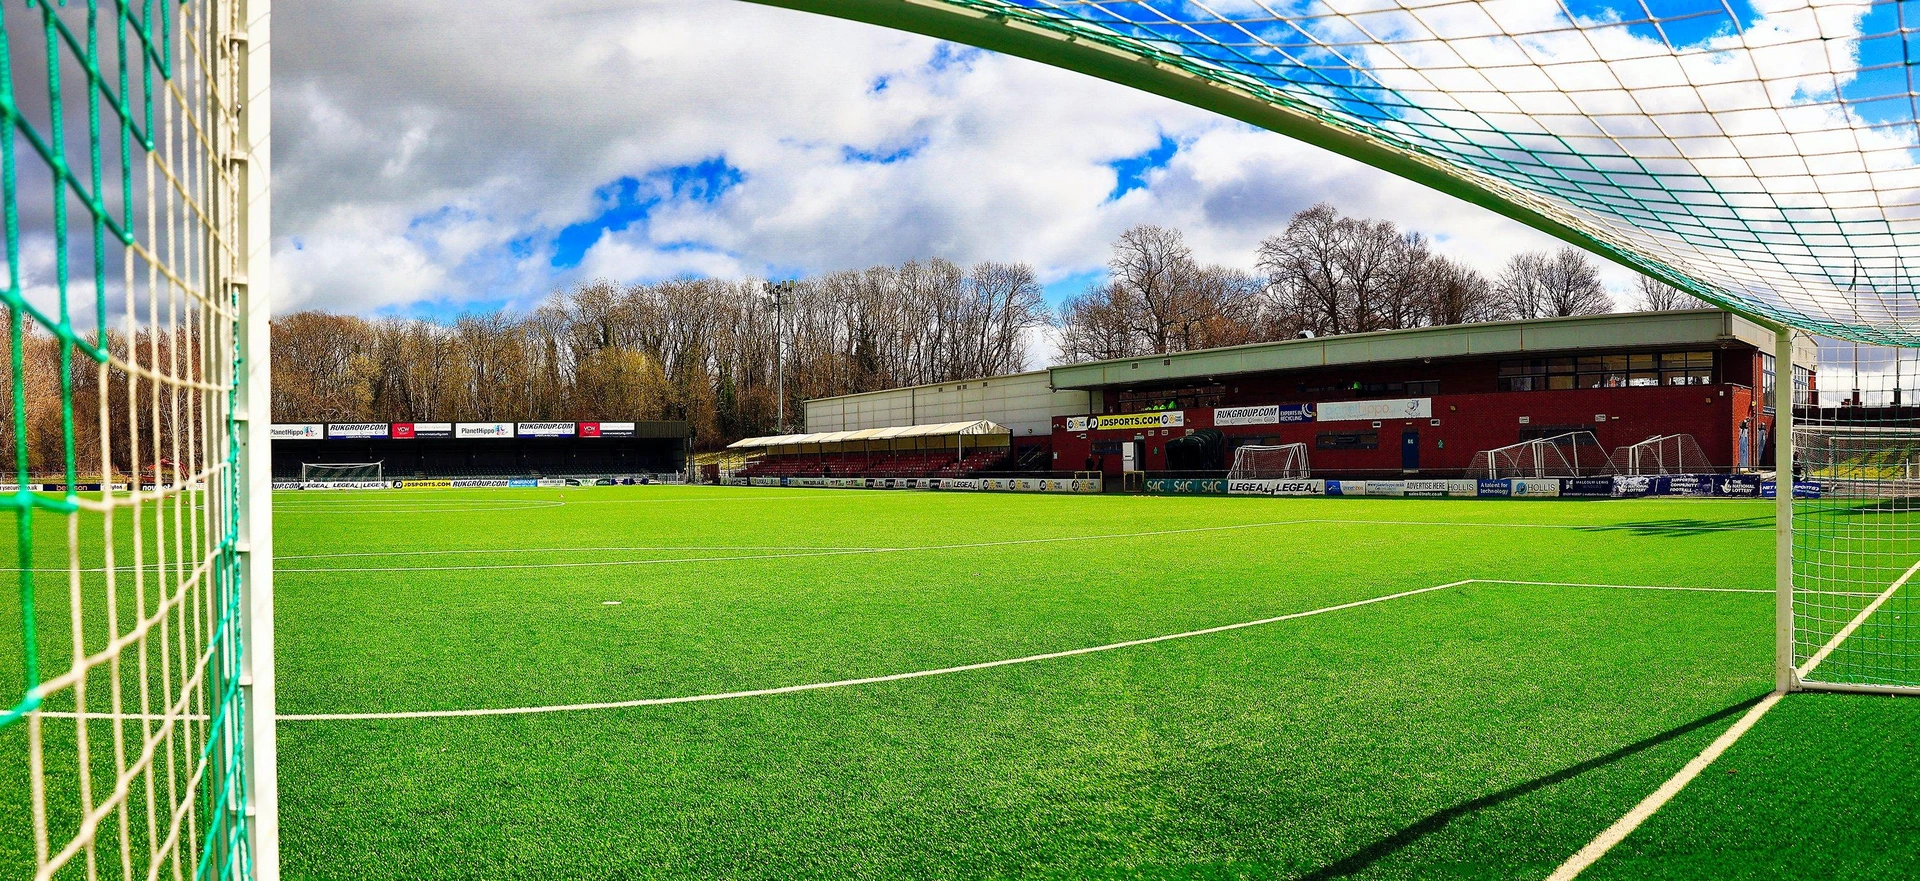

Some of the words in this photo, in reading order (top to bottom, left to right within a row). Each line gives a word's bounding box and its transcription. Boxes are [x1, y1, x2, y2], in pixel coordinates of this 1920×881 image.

[1217, 408, 1277, 418] RUKGROUP.COM
[1088, 419, 1097, 428] JD
[1100, 416, 1160, 426] JDSPORTS.COM
[1147, 481, 1164, 492] S4C
[1174, 481, 1192, 492] S4C
[1202, 481, 1222, 492] S4C
[1230, 482, 1263, 490] LEGEA
